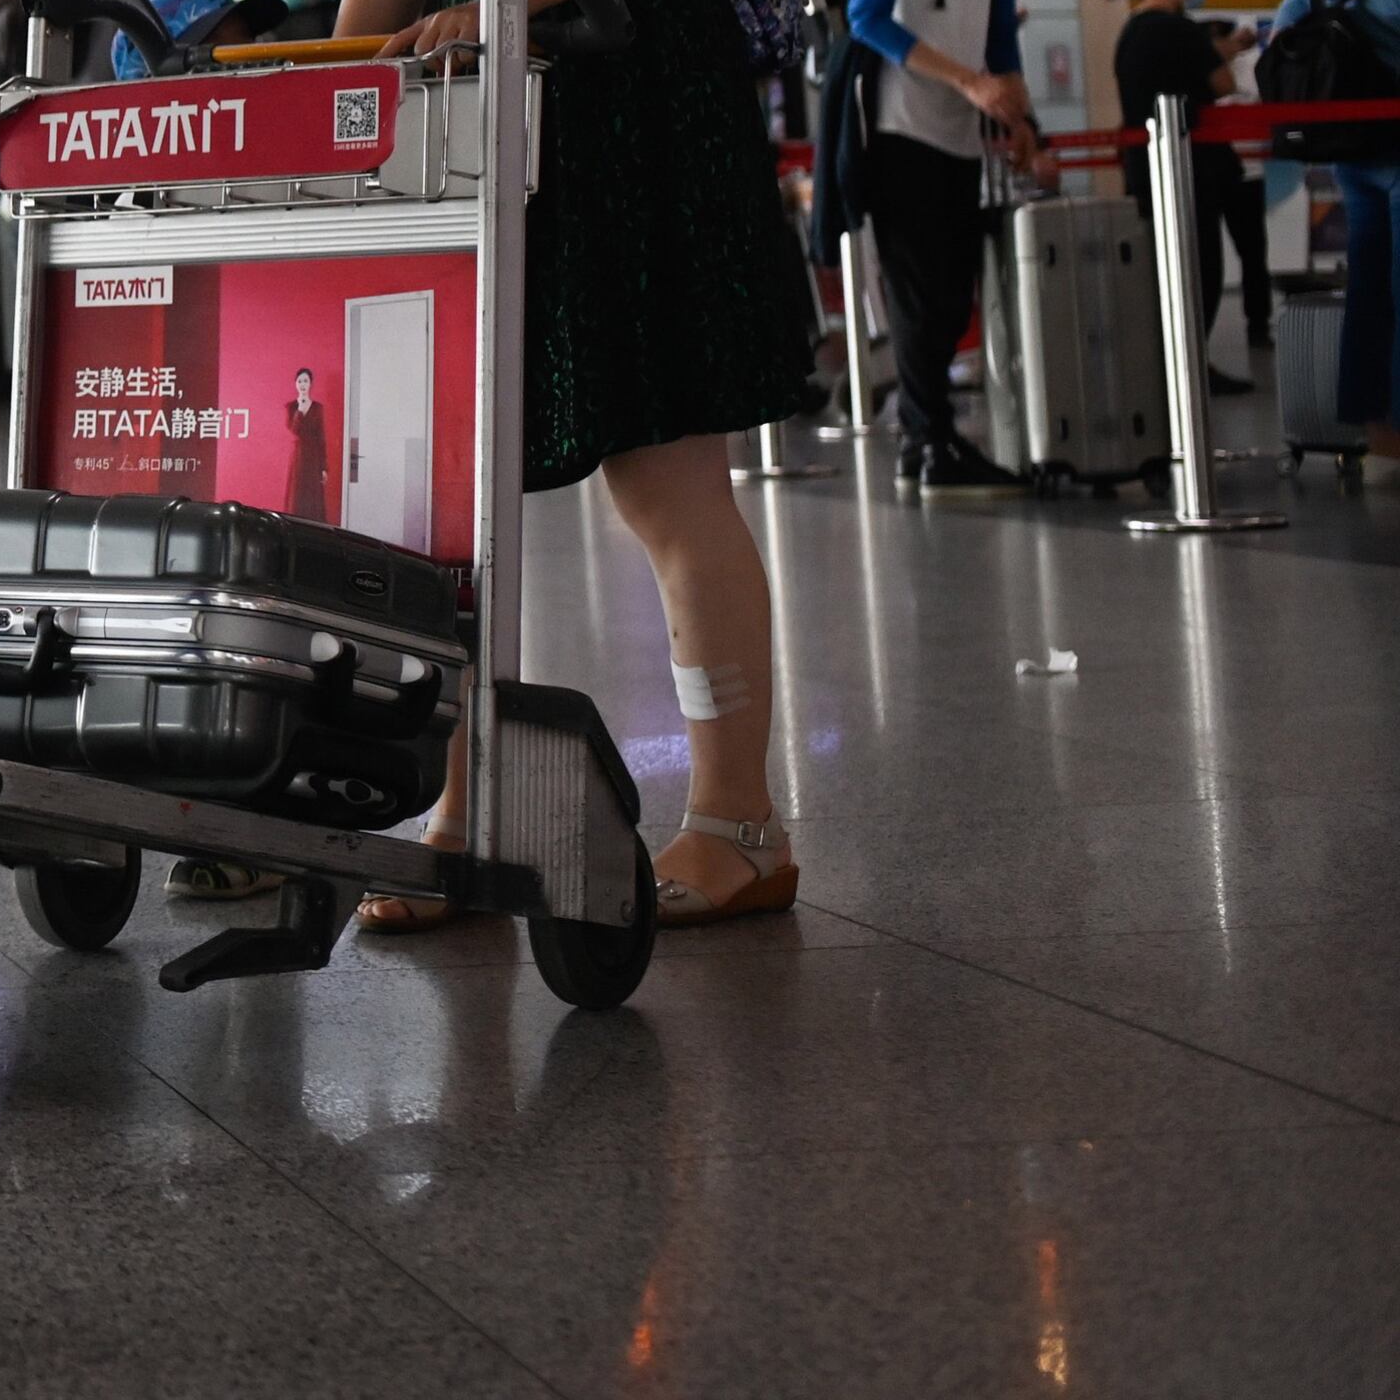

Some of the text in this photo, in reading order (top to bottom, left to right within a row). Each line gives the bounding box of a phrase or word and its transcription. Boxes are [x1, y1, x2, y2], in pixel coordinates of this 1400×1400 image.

[39, 98, 247, 163] TATA木门
[83, 277, 165, 301] TATA木门
[75, 366, 183, 399] 安静生活，
[72, 407, 250, 440] 用TATA静音门
